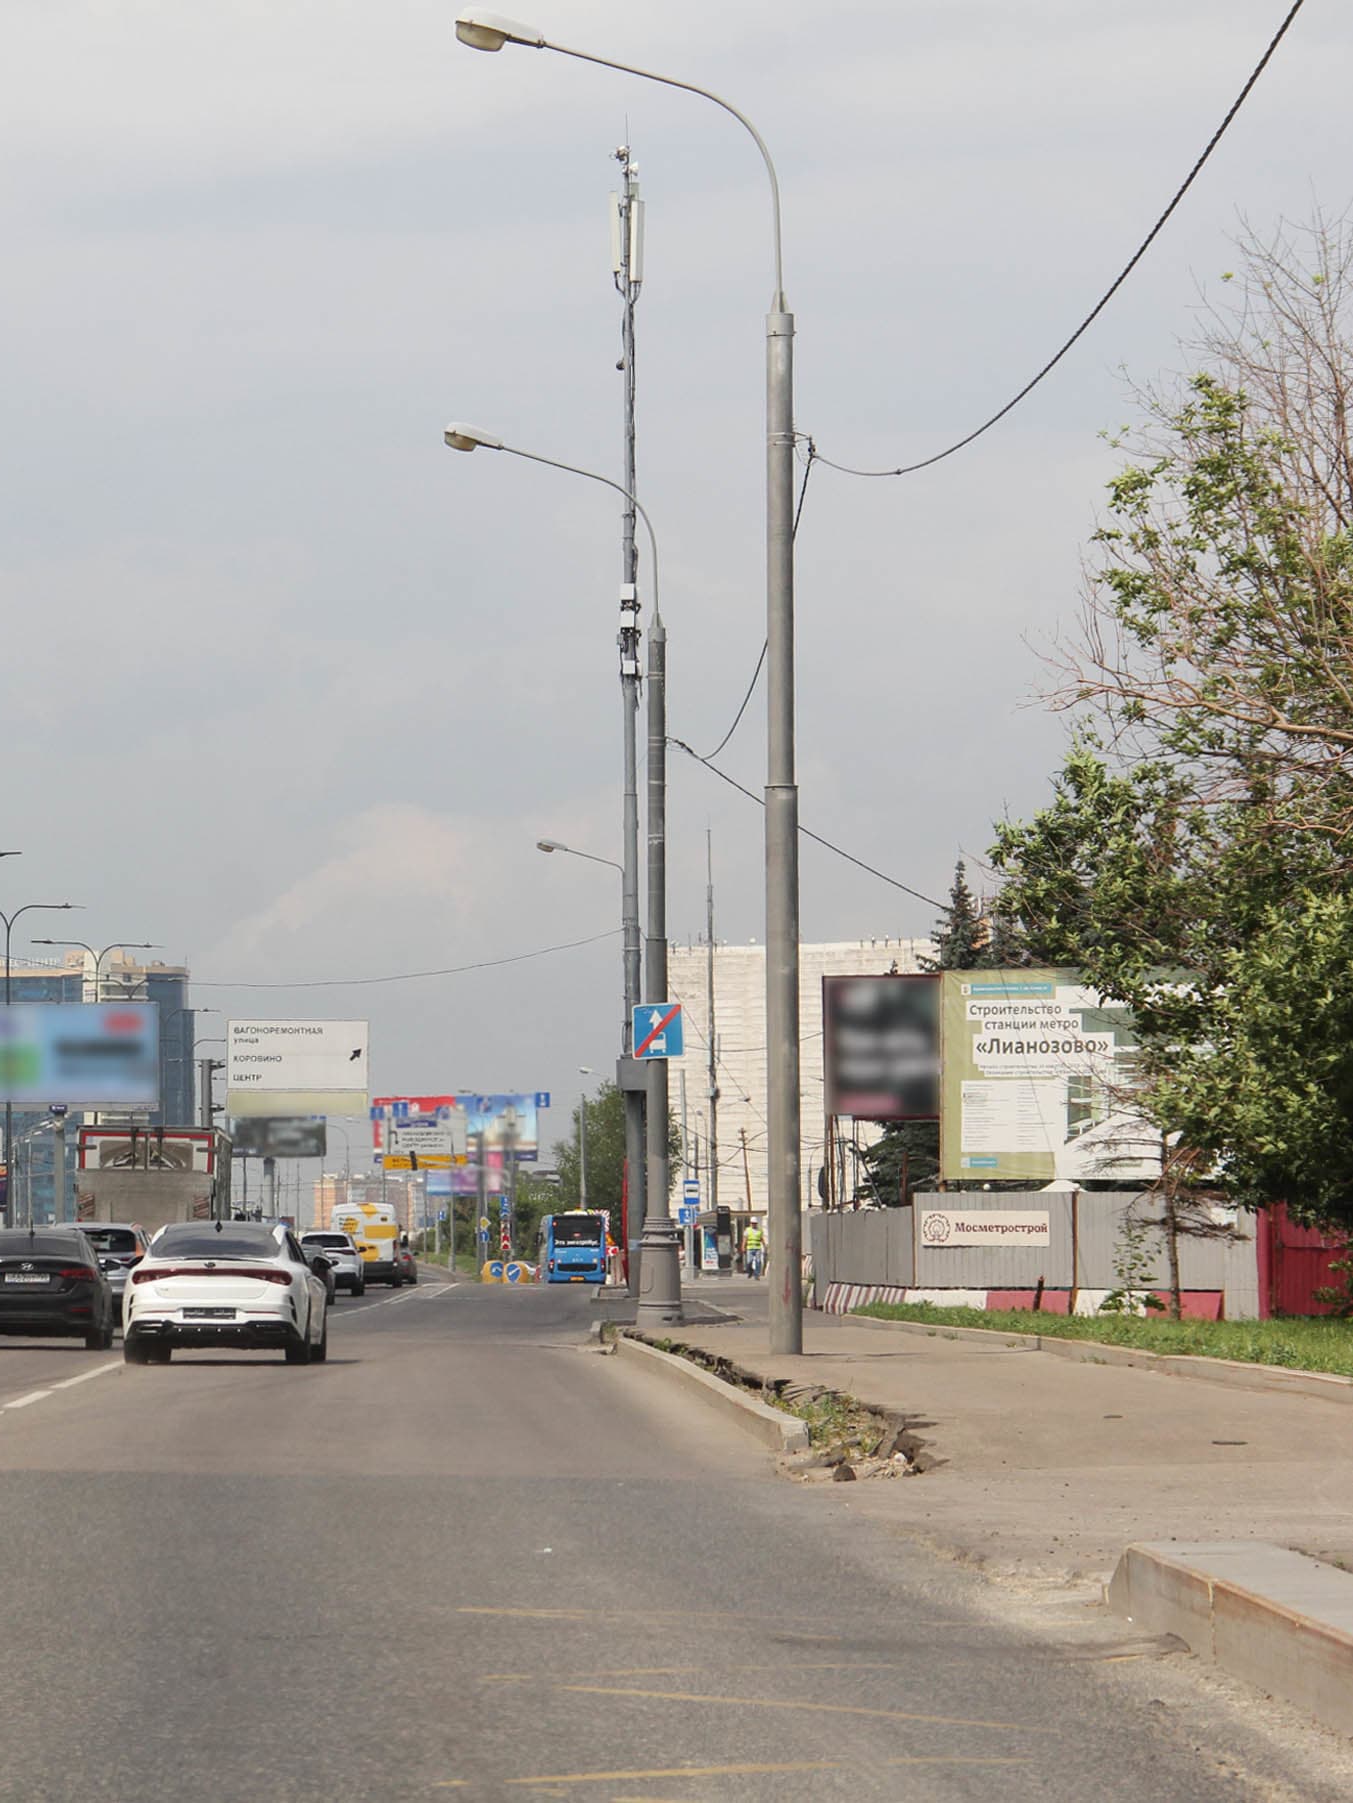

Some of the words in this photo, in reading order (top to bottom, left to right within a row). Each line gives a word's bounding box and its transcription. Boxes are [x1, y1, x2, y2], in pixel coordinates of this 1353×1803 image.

[969, 1004, 1062, 1017] Строительство
[984, 1021, 1037, 1031] станции
[1040, 1019, 1079, 1031] метро
[233, 1026, 324, 1035] ВАГОНОРЕМОНТНАЯ
[233, 1037, 260, 1045] улица
[975, 1038, 1109, 1055] «Лианозово»
[233, 1055, 283, 1063] КОРОВИНО
[233, 1073, 262, 1082] ЦЕНТР
[954, 1222, 1048, 1235] Мосметрострой
